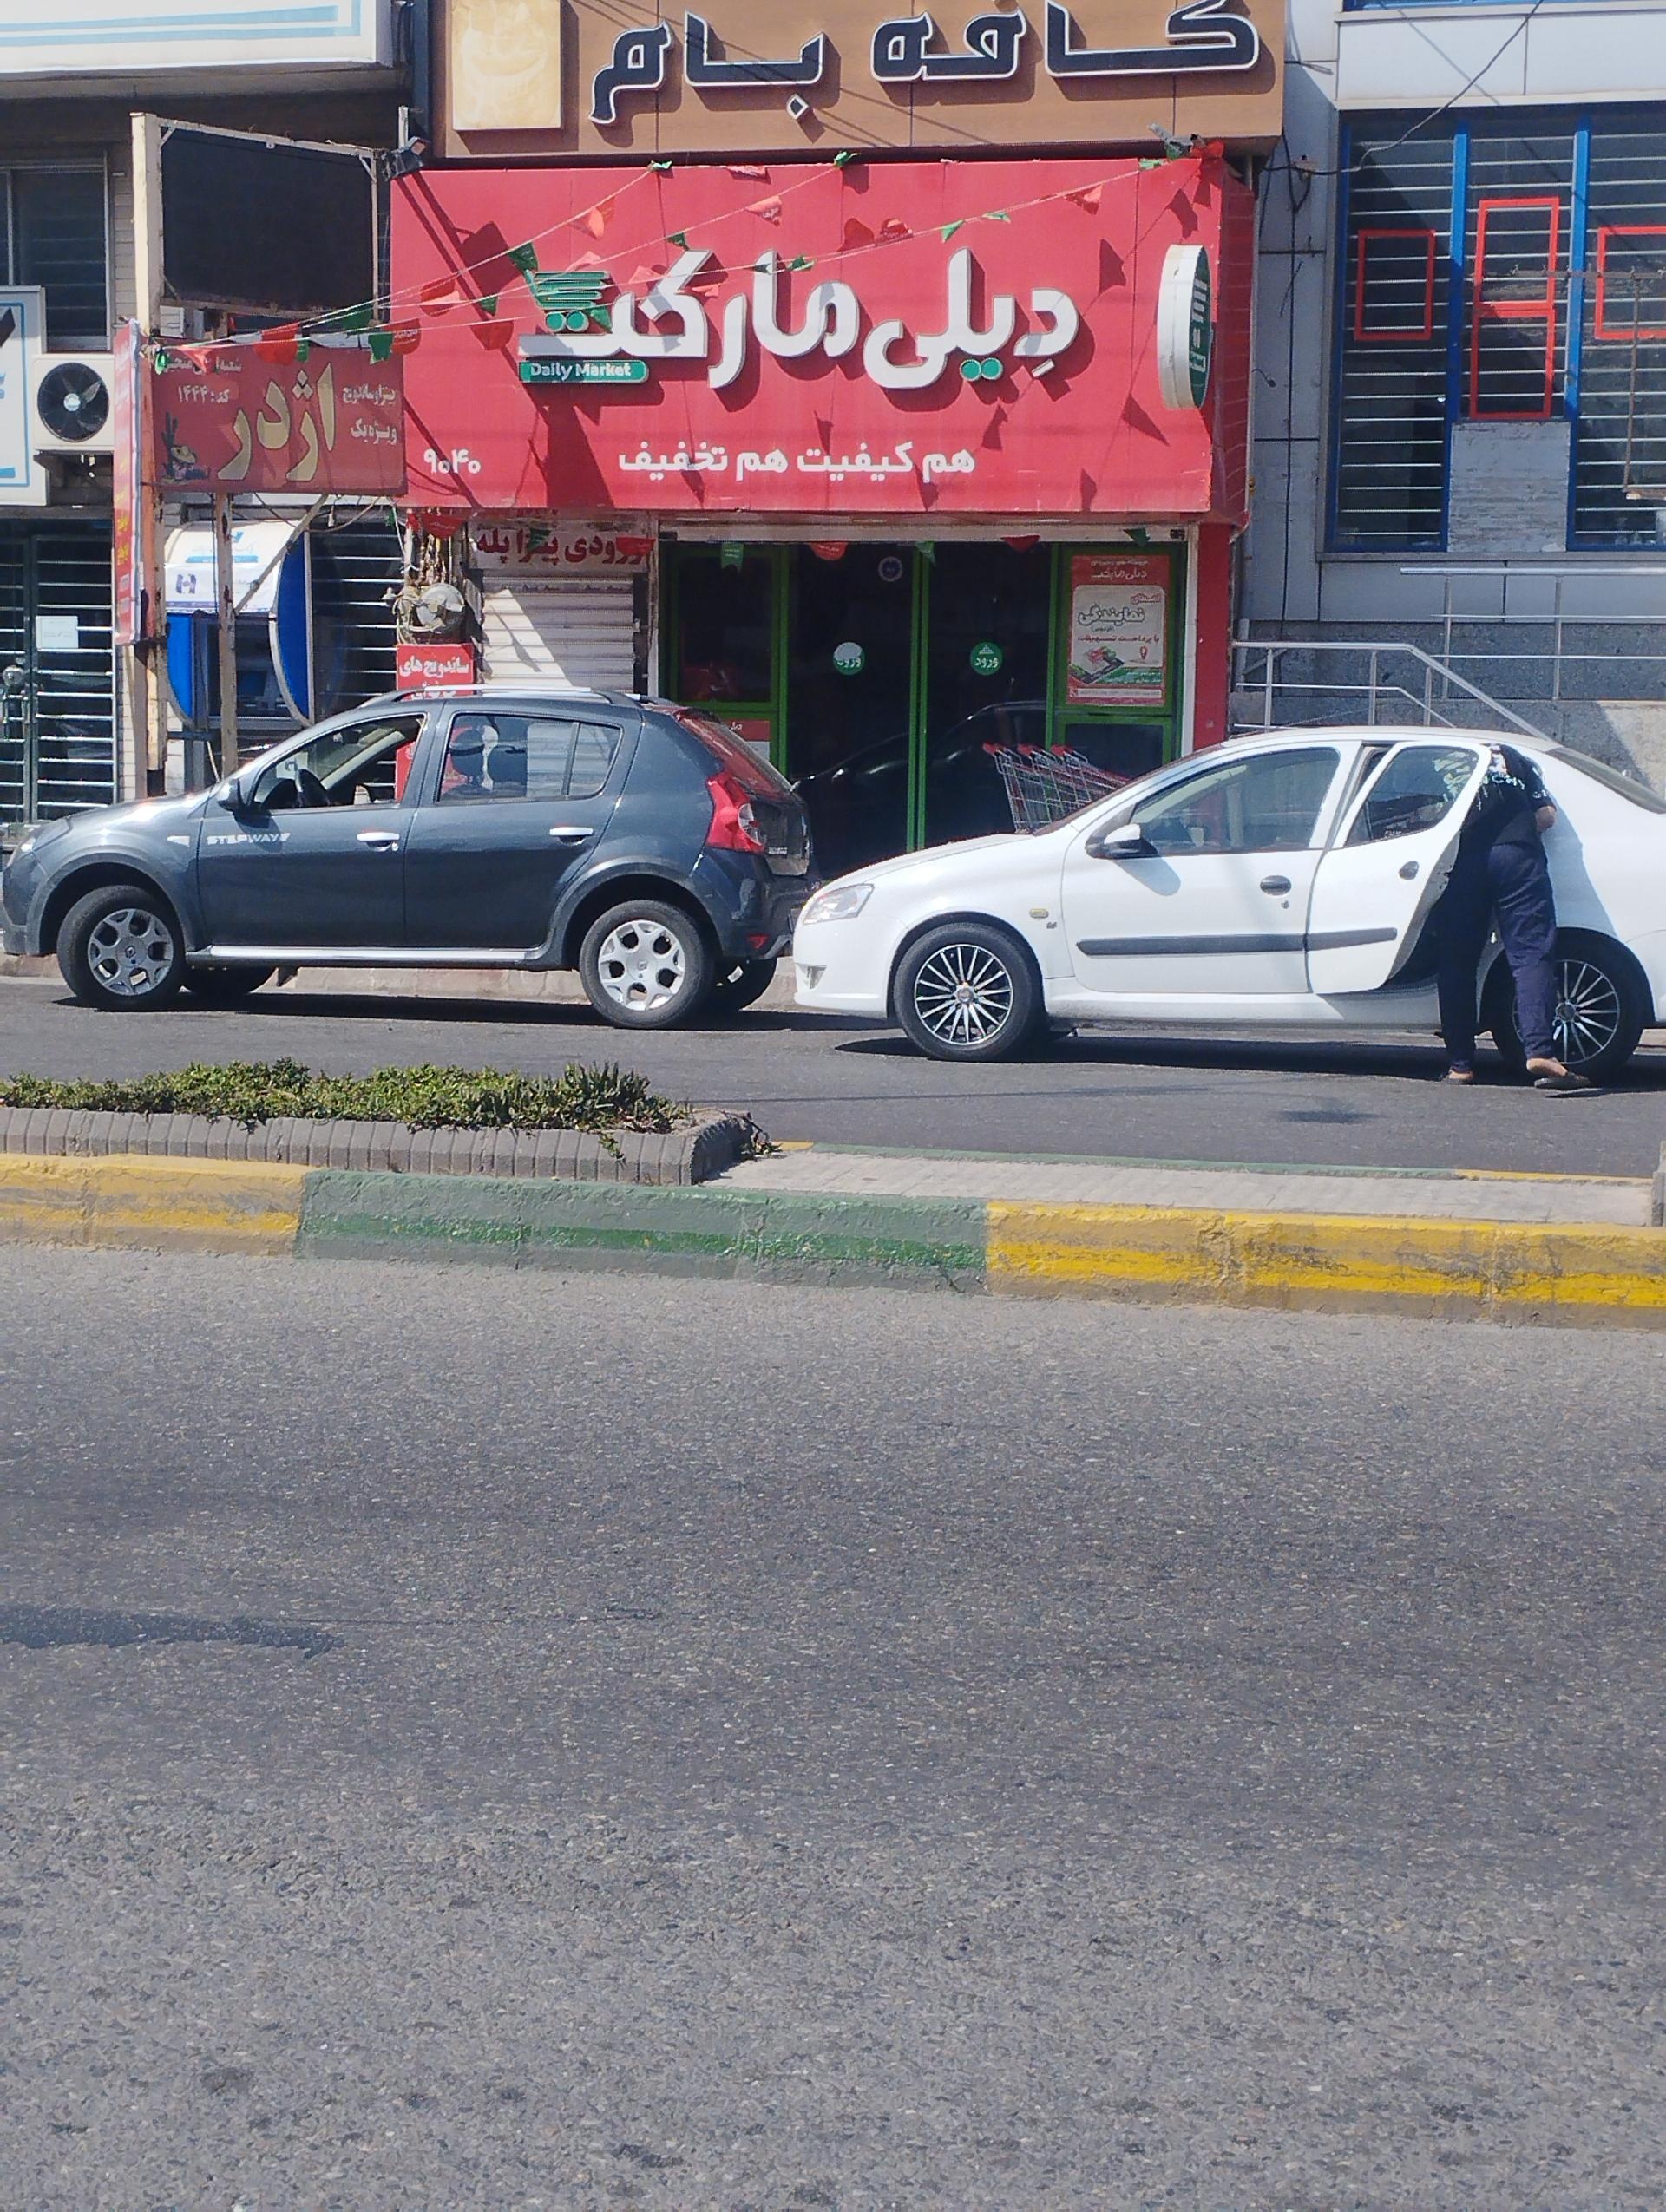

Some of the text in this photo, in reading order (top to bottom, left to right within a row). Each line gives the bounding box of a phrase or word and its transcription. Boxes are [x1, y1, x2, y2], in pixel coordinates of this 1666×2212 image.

[586, 0, 1260, 125] کافه بام
[517, 248, 861, 389] مارکت
[530, 361, 632, 380] Daily Market
[217, 362, 336, 482] اژدر
[423, 448, 482, 474] ۹۰۴۰
[618, 441, 976, 483] هم کیفیت هم تخفیف
[477, 527, 510, 564] پله
[1078, 604, 1145, 626] نمایندگی
[398, 655, 469, 678] ساندویچ های
[974, 657, 999, 669] ورود
[207, 833, 290, 846] STEPWAY
